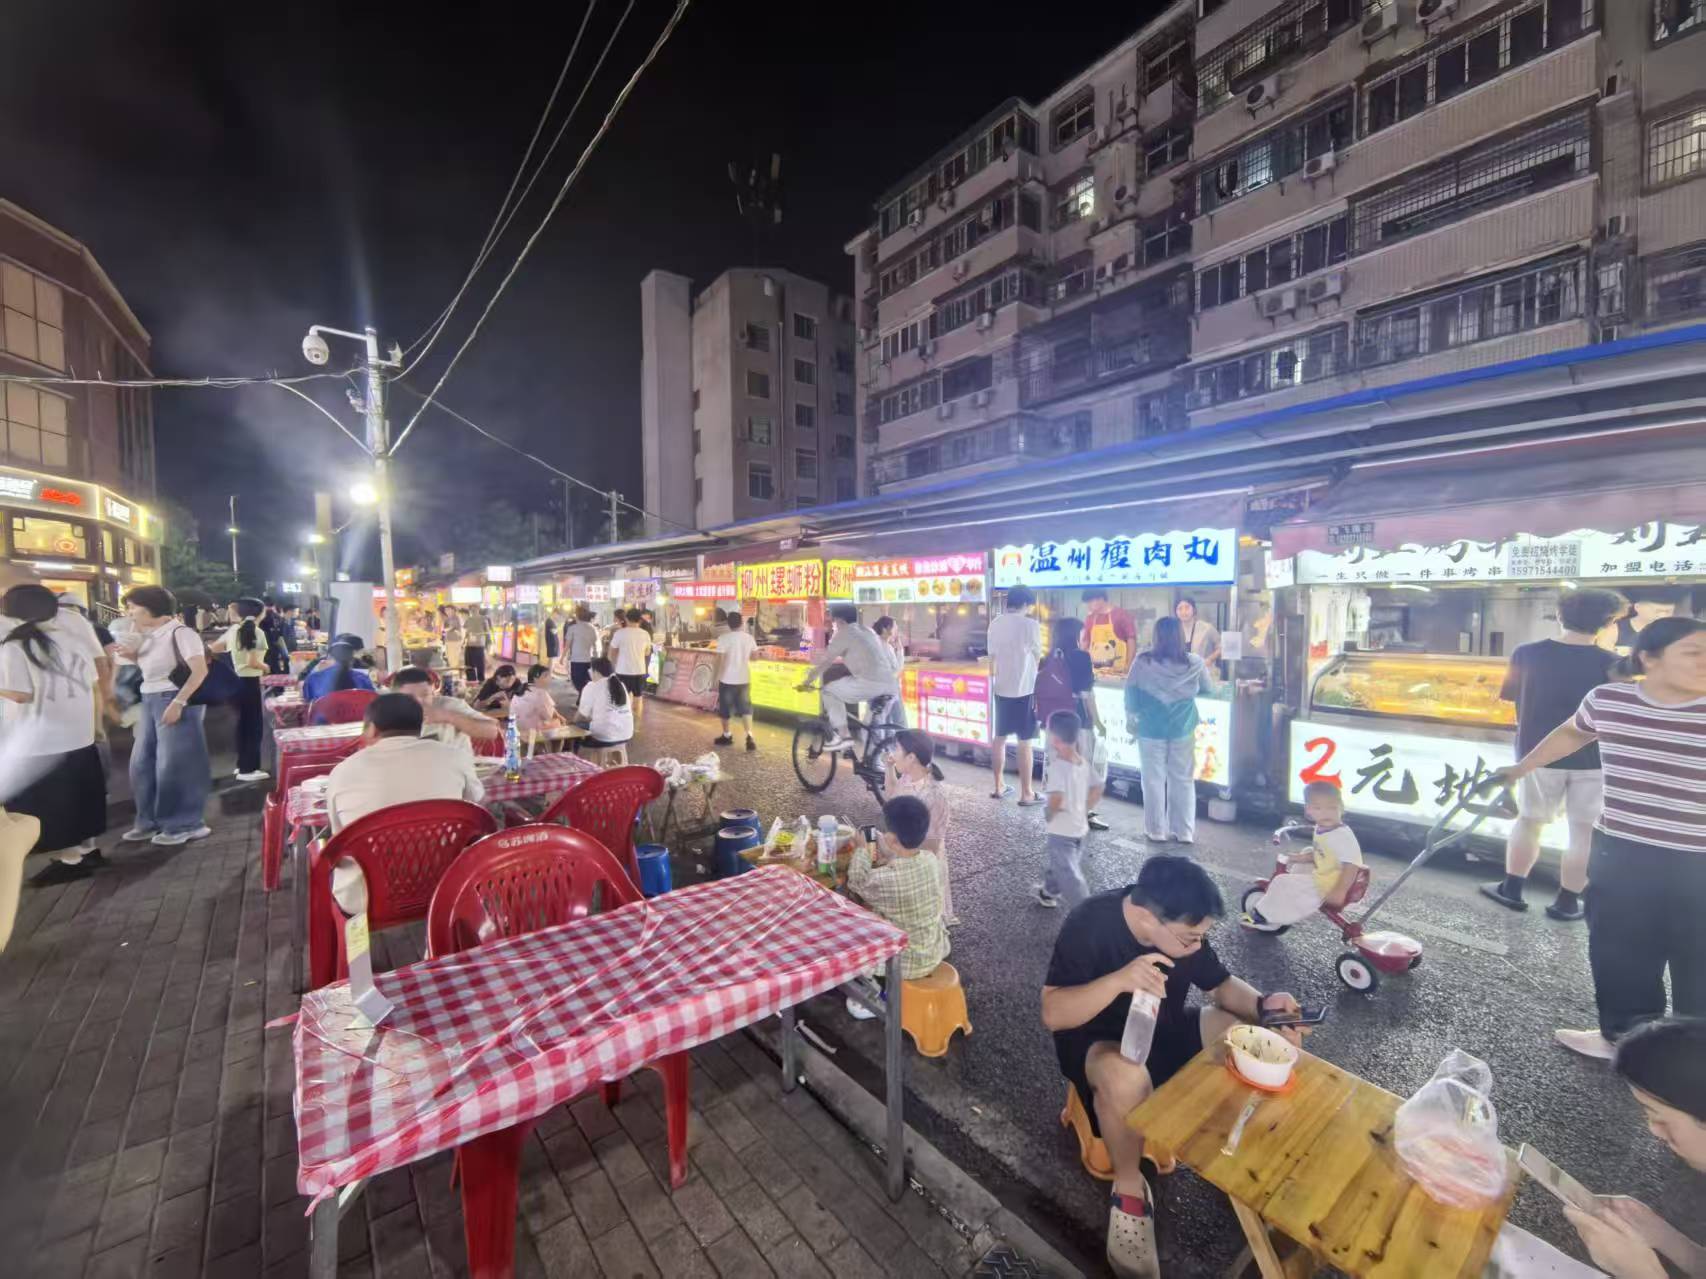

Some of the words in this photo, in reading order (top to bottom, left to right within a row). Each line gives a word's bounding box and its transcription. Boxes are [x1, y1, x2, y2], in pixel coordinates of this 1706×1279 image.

[1029, 536, 1219, 573] 温州瘦肉丸
[1600, 560, 1694, 573] 加盟电话
[741, 560, 821, 597] 柳州螺蛳粉
